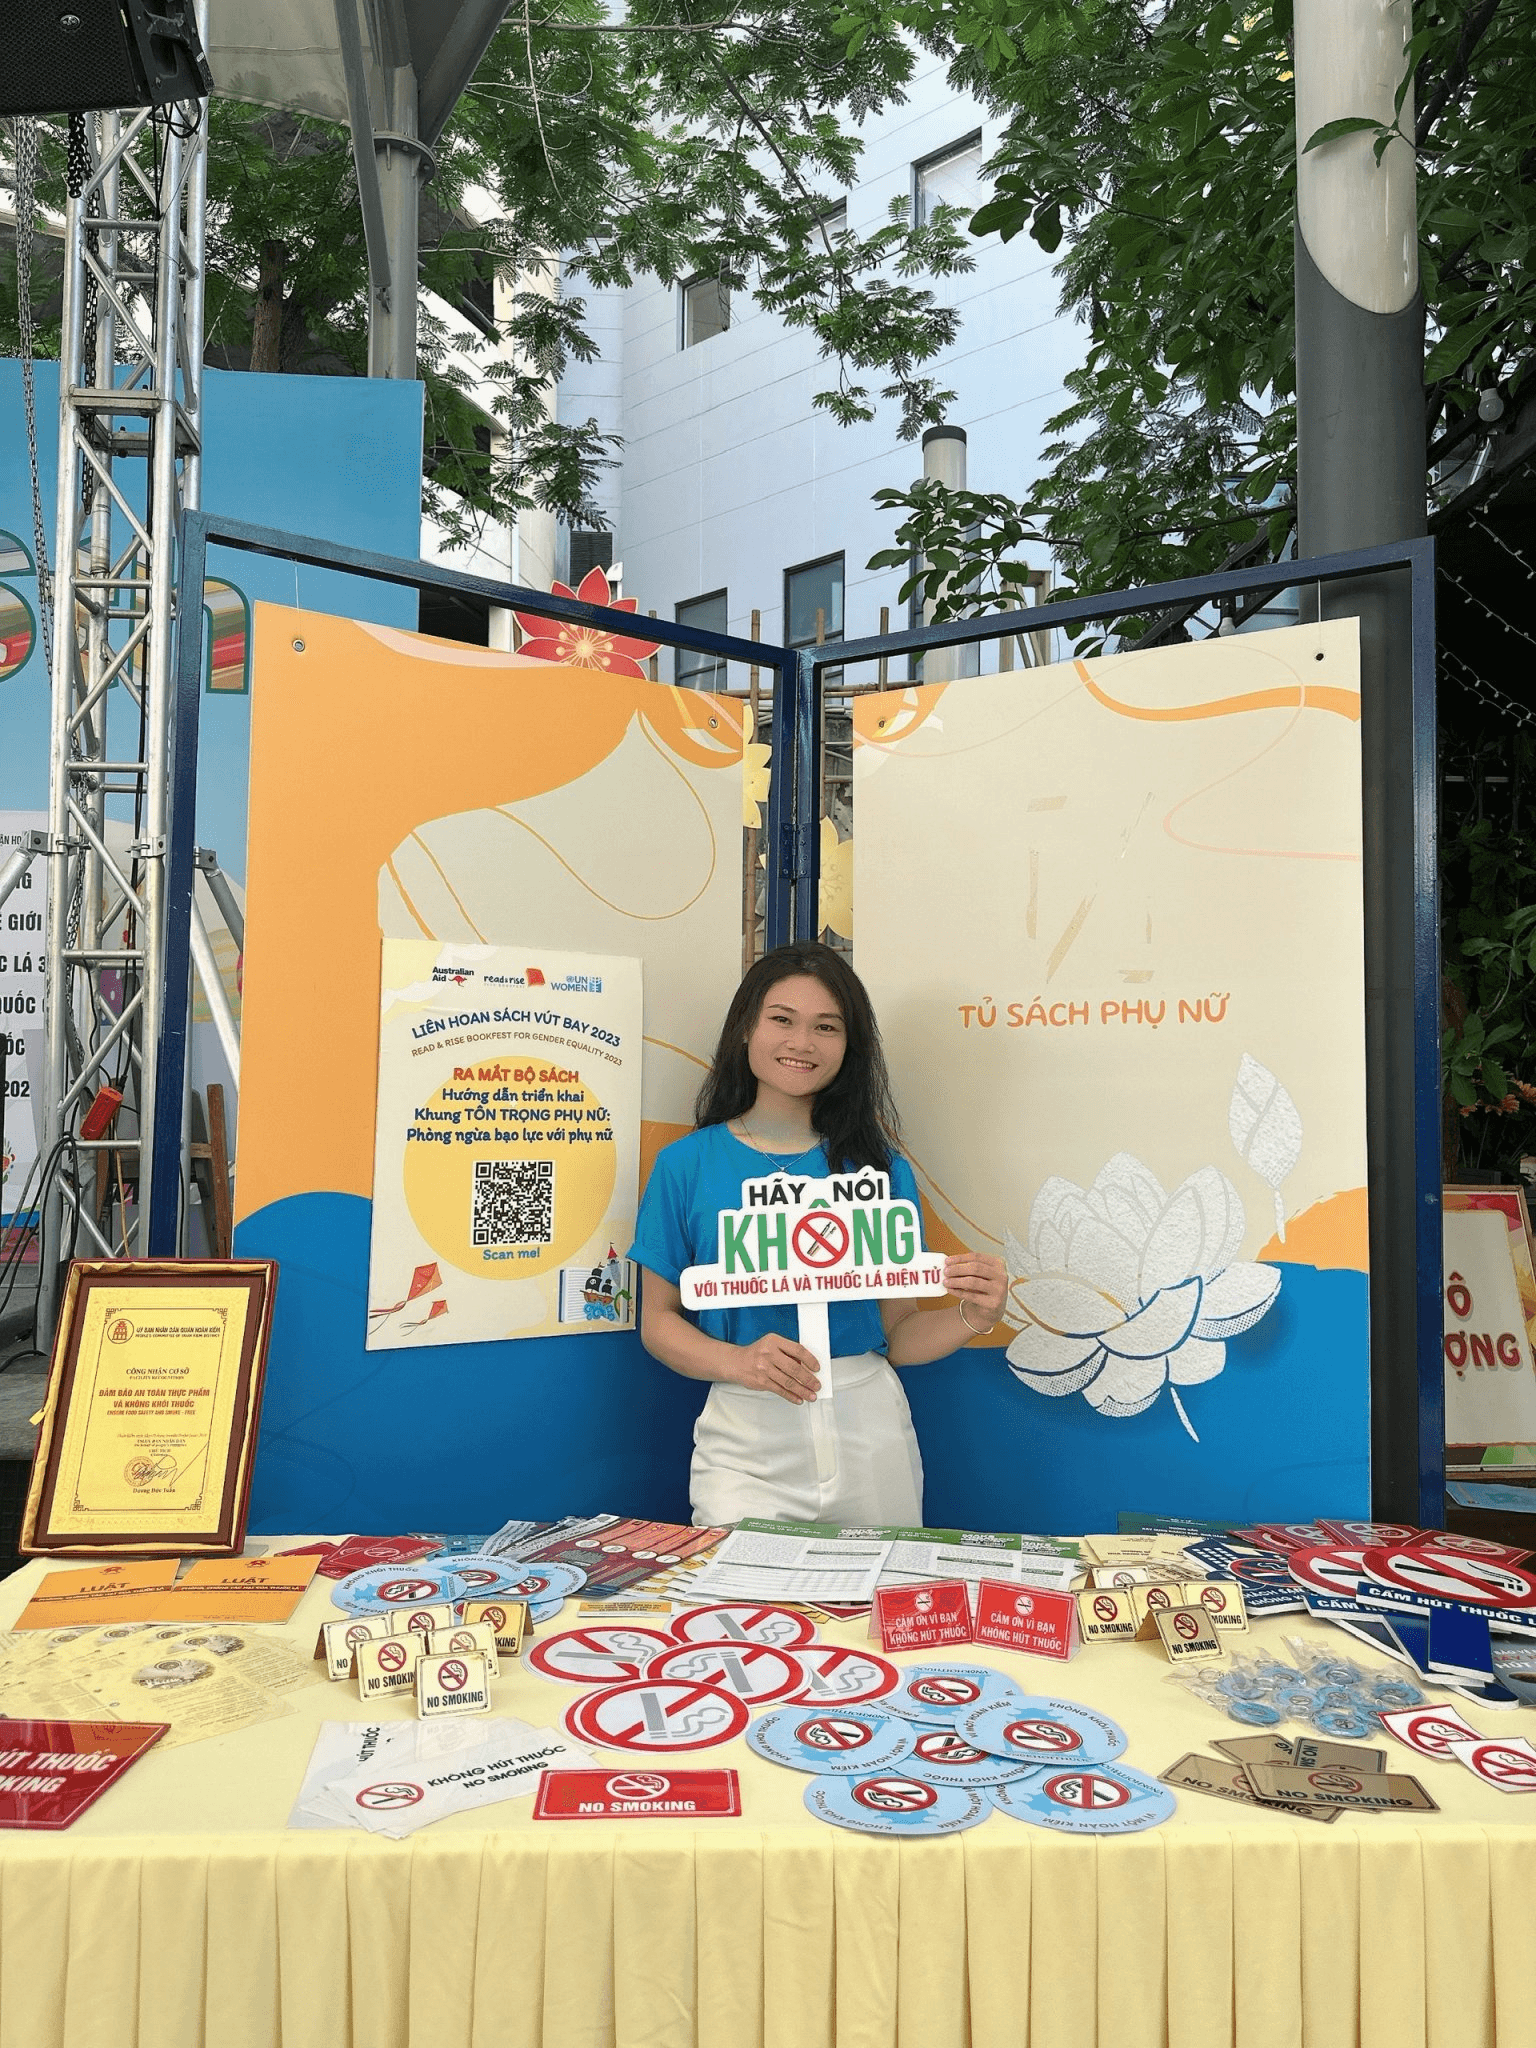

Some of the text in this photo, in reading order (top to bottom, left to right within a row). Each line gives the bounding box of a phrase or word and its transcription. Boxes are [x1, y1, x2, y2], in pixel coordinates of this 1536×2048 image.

[8, 910, 42, 931] GIỚI
[14, 951, 33, 973] LÁ
[432, 966, 475, 976] Australian
[432, 974, 447, 982] Aid
[574, 975, 588, 984] UN
[550, 983, 588, 993] WOMEN
[0, 989, 36, 1014] UỐC
[958, 991, 1232, 1031] TỦ SÁCH PHỤ NỮ
[411, 1006, 621, 1047] LIÊN HOAN SÁCH VÚT BAY 2023
[411, 1031, 623, 1067] READ & RISE BOOKFEST FOR GENDER EQUALITY 2023
[453, 1063, 579, 1084] RA MẮT BỘ SÁCH
[442, 1087, 584, 1105] Hướng dẫn triển khai
[414, 1105, 611, 1124] Khung TÔN TRỌNG PHỤ NỮ:
[406, 1127, 614, 1145] Phòng ngừa bạo lực với phụ nữ
[748, 1171, 885, 1207] HÃY NÓI
[483, 1246, 540, 1261] Scan me!
[693, 1265, 942, 1298] VỚI THUỐC LÁ VÀ THUỐC LÁ ĐIỆN TỬ
[134, 1389, 146, 1397] AN
[147, 1388, 167, 1397] TOÀN
[124, 1399, 150, 1408] KHÔNG
[171, 1399, 195, 1408] THUỐC
[1316, 1598, 1360, 1610] CẤM
[1368, 1586, 1412, 1602] CẤM
[1416, 1596, 1454, 1610] HÚT
[1458, 1603, 1523, 1623] THUỐC
[939, 1611, 958, 1625] BẠN
[1011, 1615, 1024, 1627] ƠN
[1025, 1617, 1035, 1630] VÌ
[1037, 1620, 1056, 1635] BẠN
[889, 1625, 968, 1646] KHÔNG HÚT THUỐC
[1088, 1622, 1134, 1635] NO SMOKING
[980, 1625, 1062, 1651] KHÔNG HÚT THUỐC
[1171, 1639, 1218, 1655] NO SMOKING
[336, 1657, 348, 1669] NO
[368, 1678, 381, 1691] NO
[426, 1690, 484, 1708] NO SMOKING
[1048, 1701, 1089, 1717] KHÔNG
[27, 1748, 118, 1772] THUỐC
[427, 1744, 568, 1787] KHÔNG HÚT THUỐC
[830, 1763, 860, 1772] KIẾM
[861, 1754, 892, 1769] HOÀN
[463, 1760, 550, 1789] NO SMOKING
[922, 1772, 998, 1783] KHÓI THUỐC
[1182, 1775, 1213, 1789] NO
[1276, 1788, 1413, 1807] NO SMOKING
[578, 1799, 697, 1814] NO SMOKING
[846, 1818, 893, 1831] KHÔNG
[1041, 1816, 1075, 1827] KIẾM
